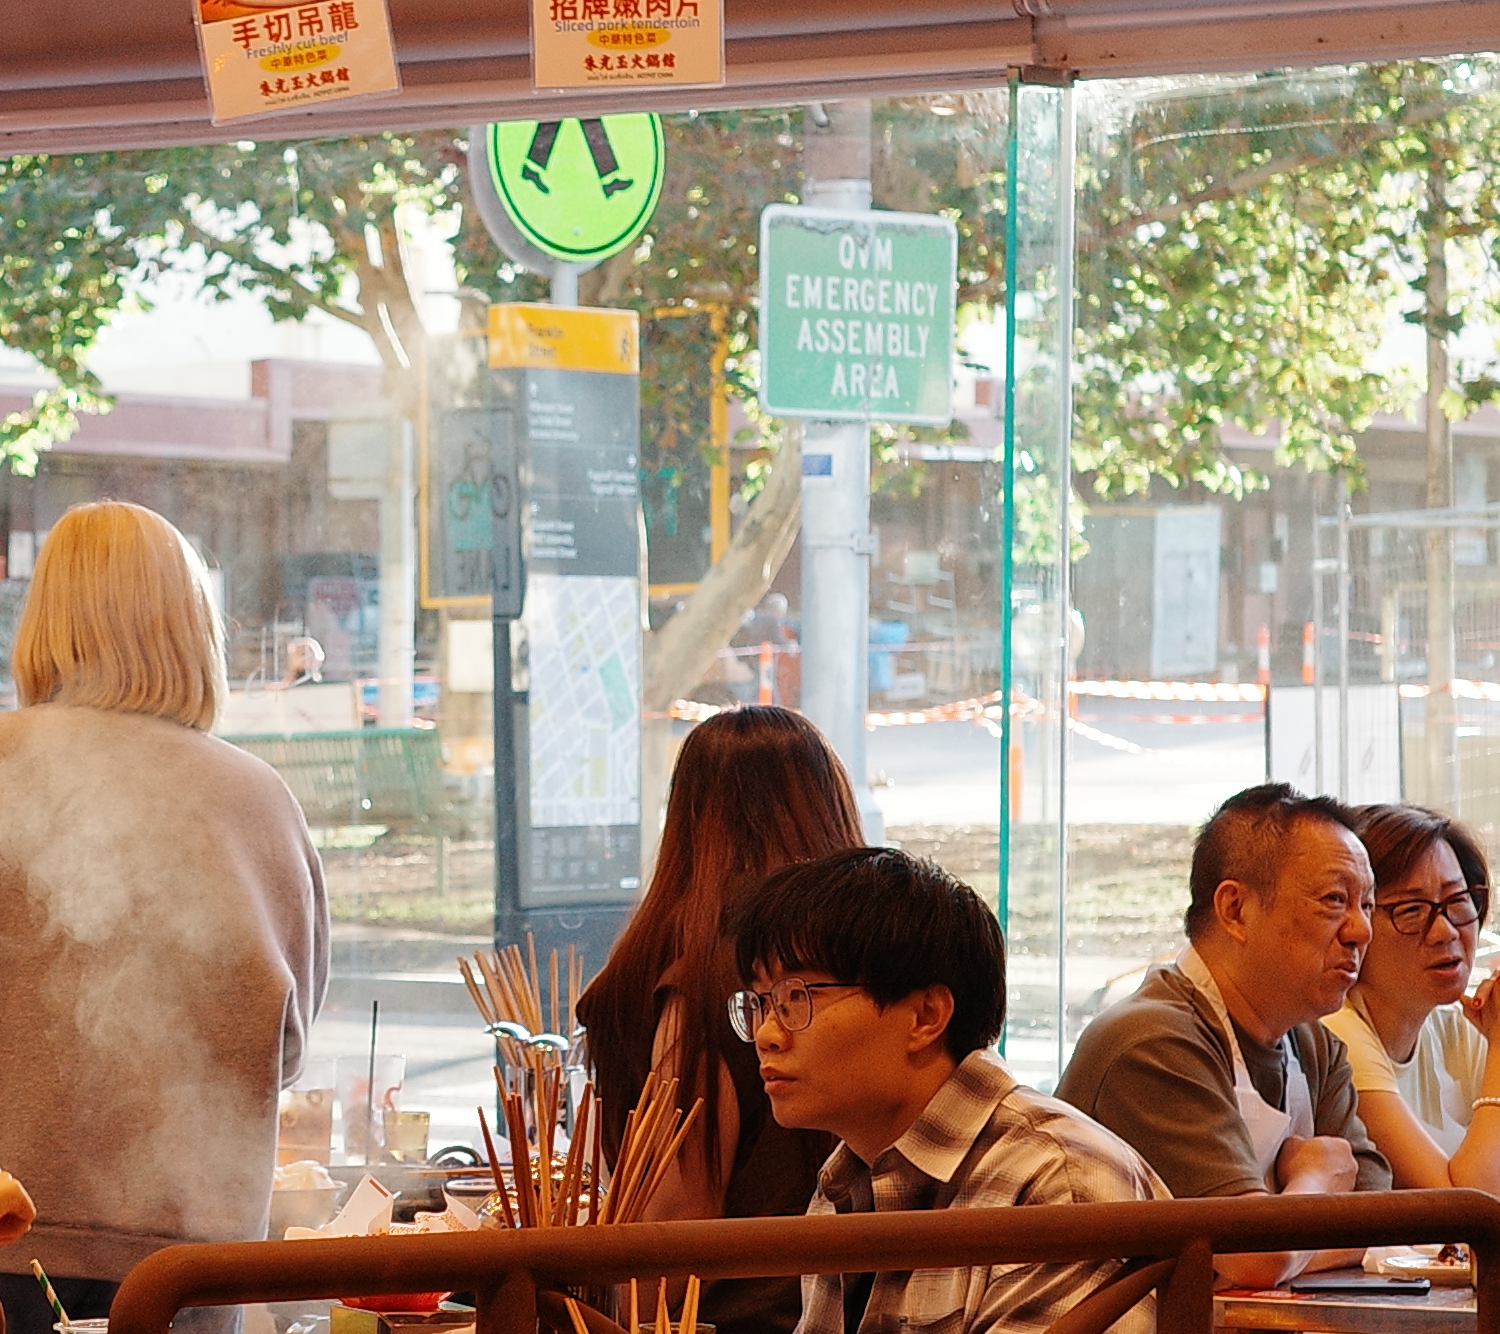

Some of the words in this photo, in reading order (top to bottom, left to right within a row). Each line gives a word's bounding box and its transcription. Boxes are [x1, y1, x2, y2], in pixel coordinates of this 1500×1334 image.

[231, 0, 360, 51] 手切吊龍
[554, 19, 595, 33] Sliced
[597, 17, 629, 33] pork
[631, 15, 701, 30] tenderloin
[245, 41, 293, 61] Freshly
[296, 36, 317, 50] cut
[319, 31, 350, 48] beef
[836, 240, 895, 273] QVM
[784, 279, 939, 320] EMERGENCY
[796, 318, 931, 360] ASSEMBLY
[830, 359, 901, 402] AREA
